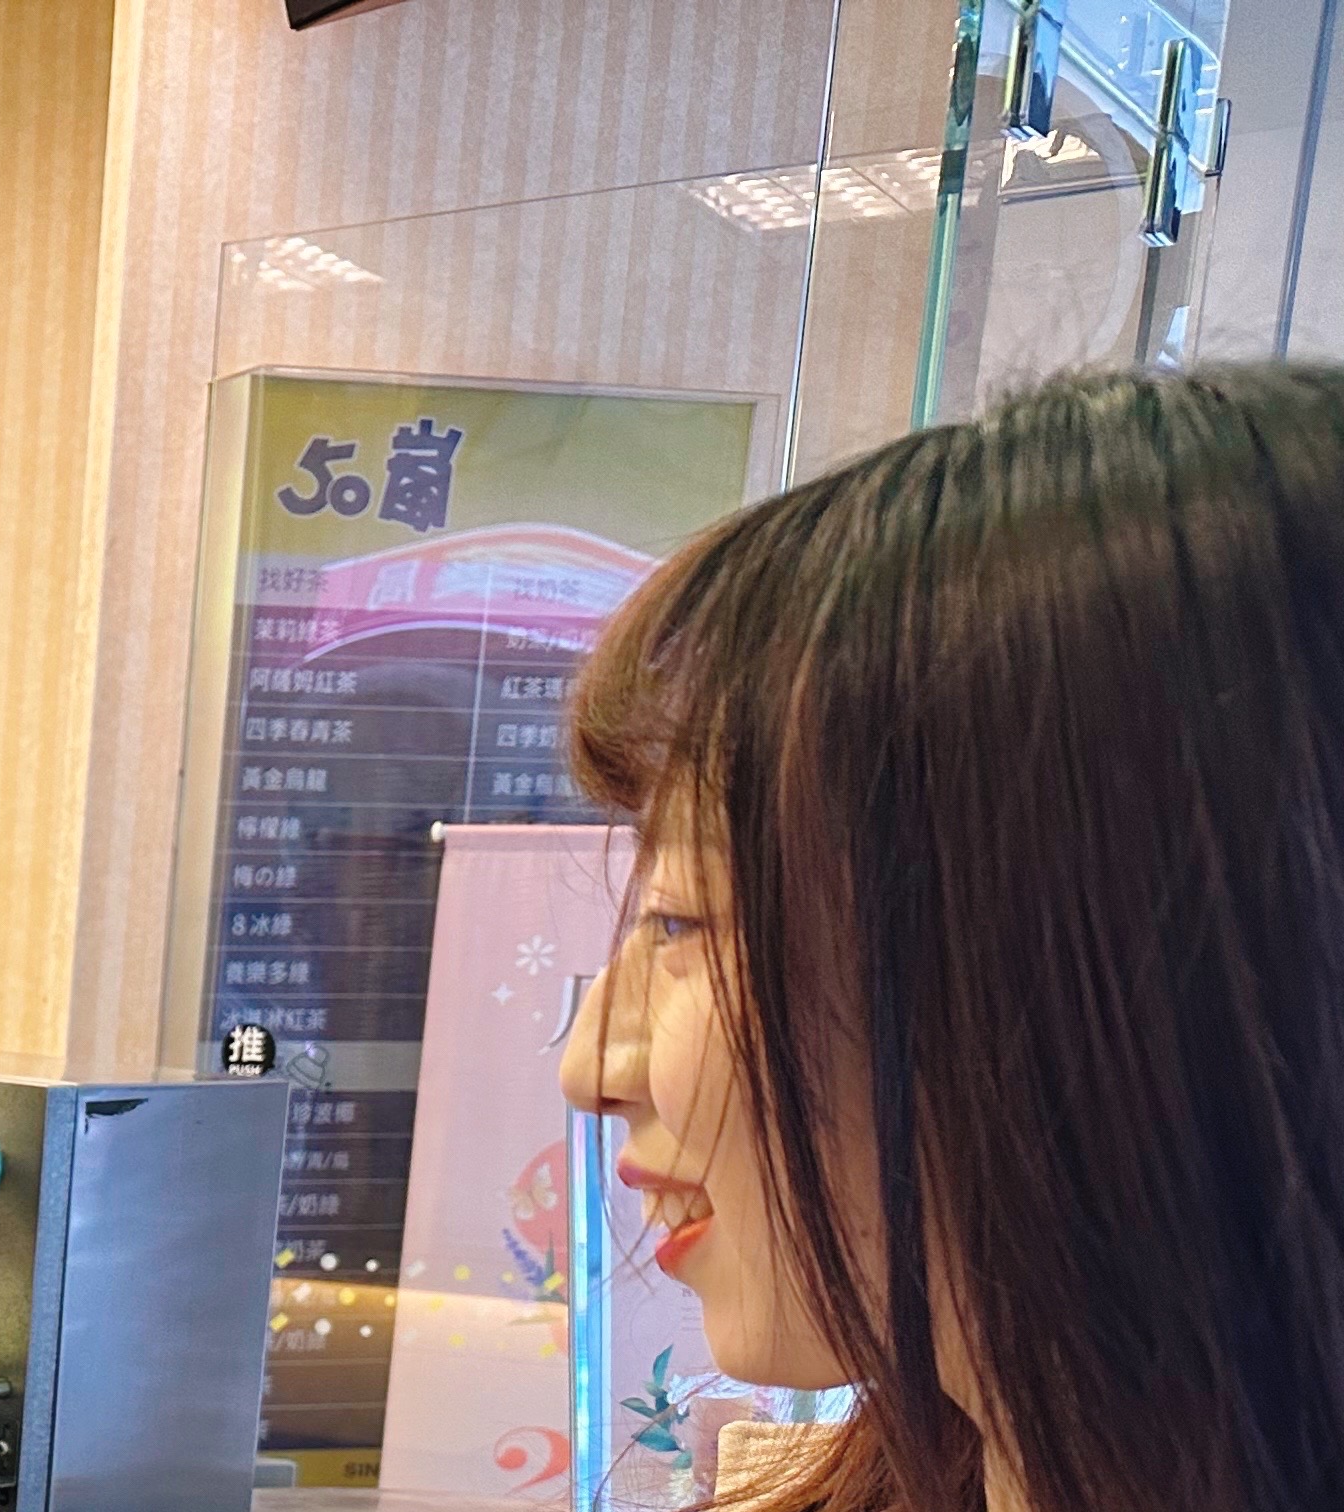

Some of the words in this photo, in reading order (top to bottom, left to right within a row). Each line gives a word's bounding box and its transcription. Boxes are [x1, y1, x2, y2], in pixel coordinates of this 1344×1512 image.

[277, 419, 464, 532] 50嵐
[258, 567, 328, 593] 找好茶
[249, 669, 358, 695] 阿薩姆紅茶
[245, 718, 353, 744] 四季春青茶
[241, 768, 328, 793] 黃金烏龍
[229, 1025, 266, 1062] 推
[228, 1064, 264, 1076] PUSH
